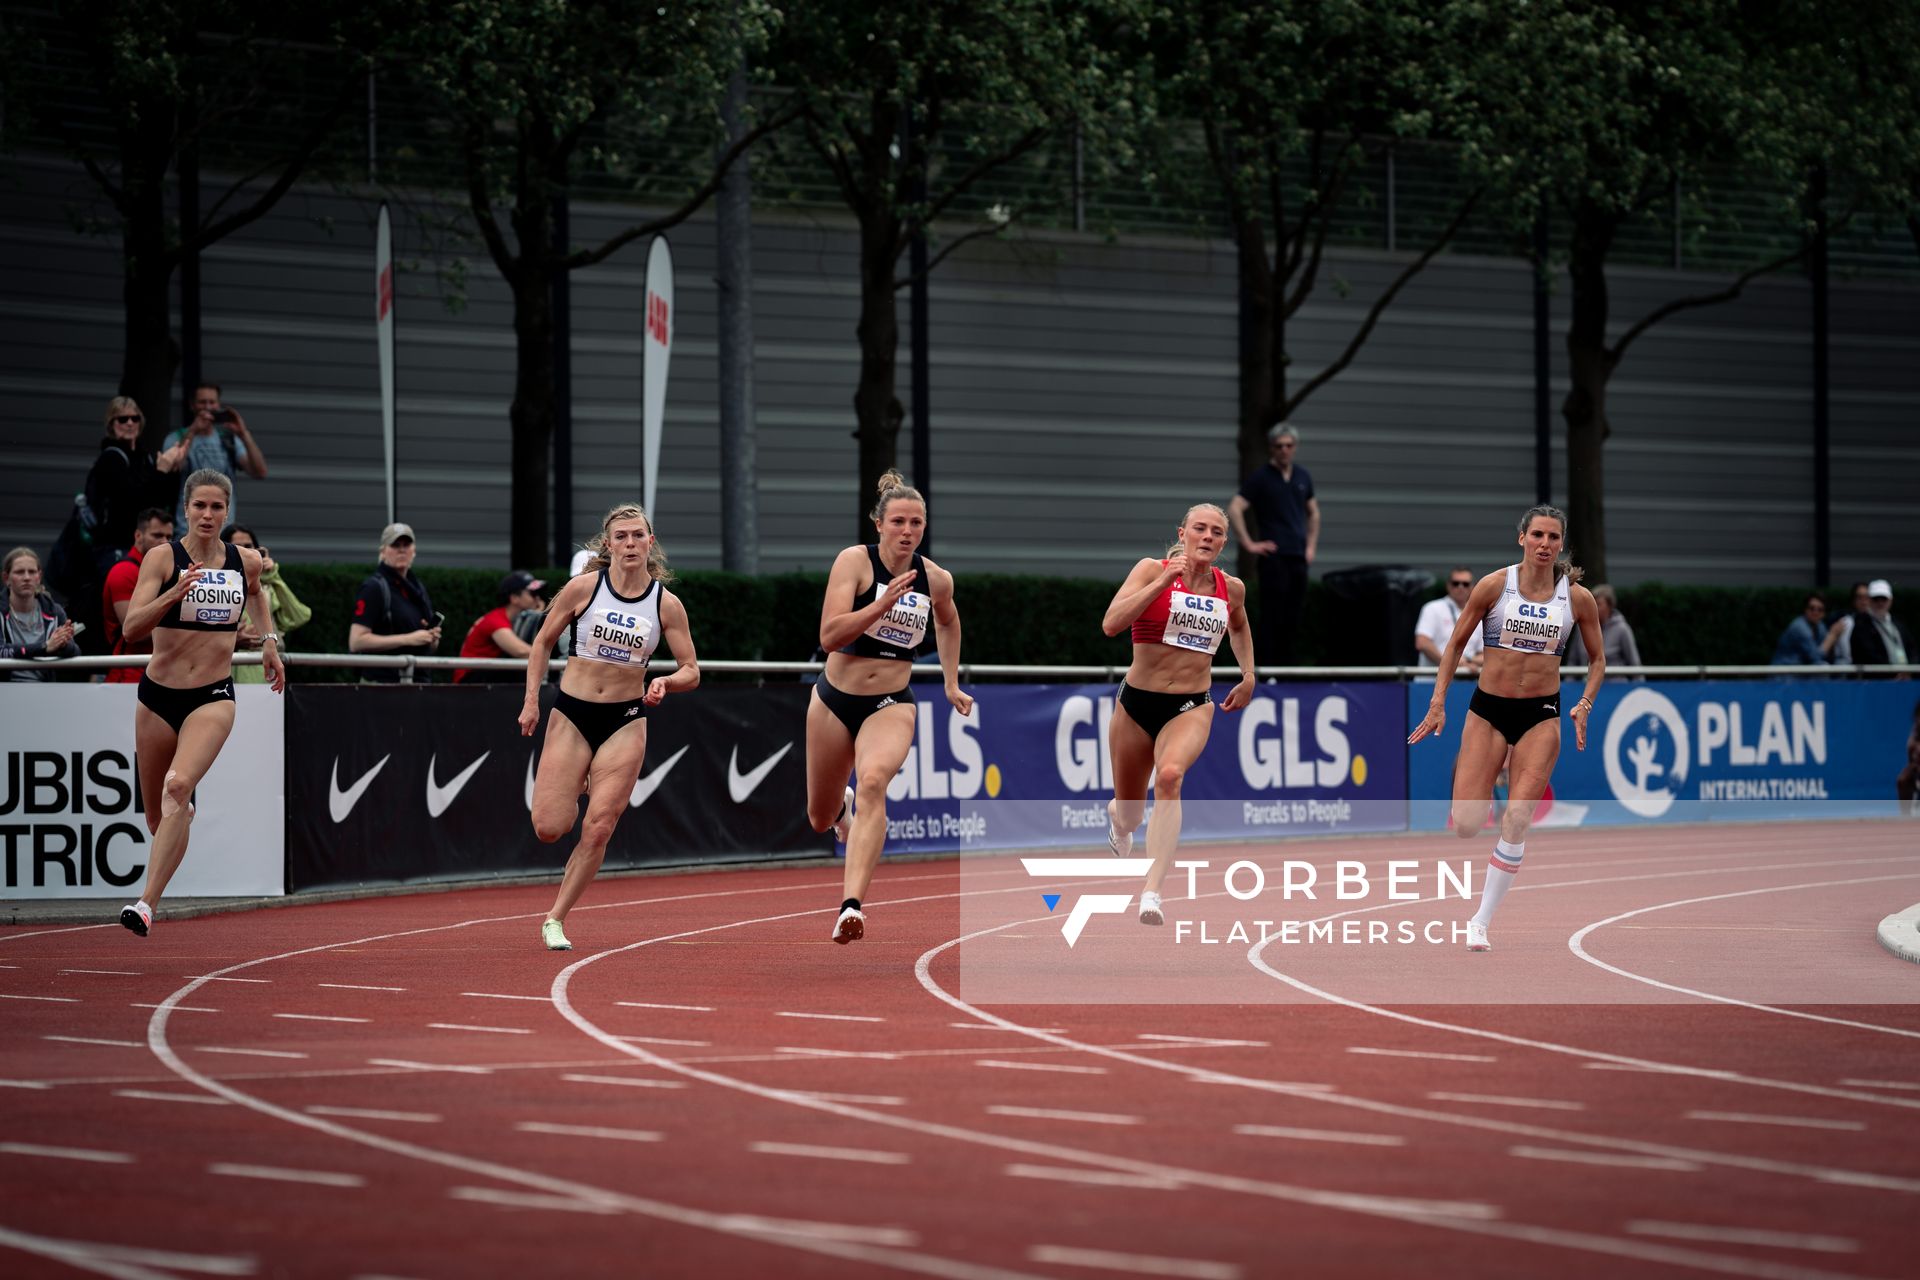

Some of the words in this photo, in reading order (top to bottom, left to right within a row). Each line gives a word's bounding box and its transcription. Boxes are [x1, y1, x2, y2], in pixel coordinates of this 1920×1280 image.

[186, 585, 241, 604] RÖSING
[881, 609, 926, 630] AUDENS
[1172, 612, 1225, 635] KARLSSON
[1506, 618, 1560, 638] OBERMAIER
[593, 625, 643, 648] BURNS
[892, 631, 911, 640] PLAN
[1192, 636, 1211, 645] PLAN
[611, 649, 629, 658] PLAN
[1698, 701, 1827, 765] PLAN
[1700, 778, 1827, 801] INTERNATIONAL
[1061, 803, 1107, 828] Parcels
[1243, 800, 1290, 824] Parcels
[1291, 801, 1307, 822] to
[1308, 798, 1351, 827] People
[927, 815, 942, 838] to
[942, 812, 986, 843] People
